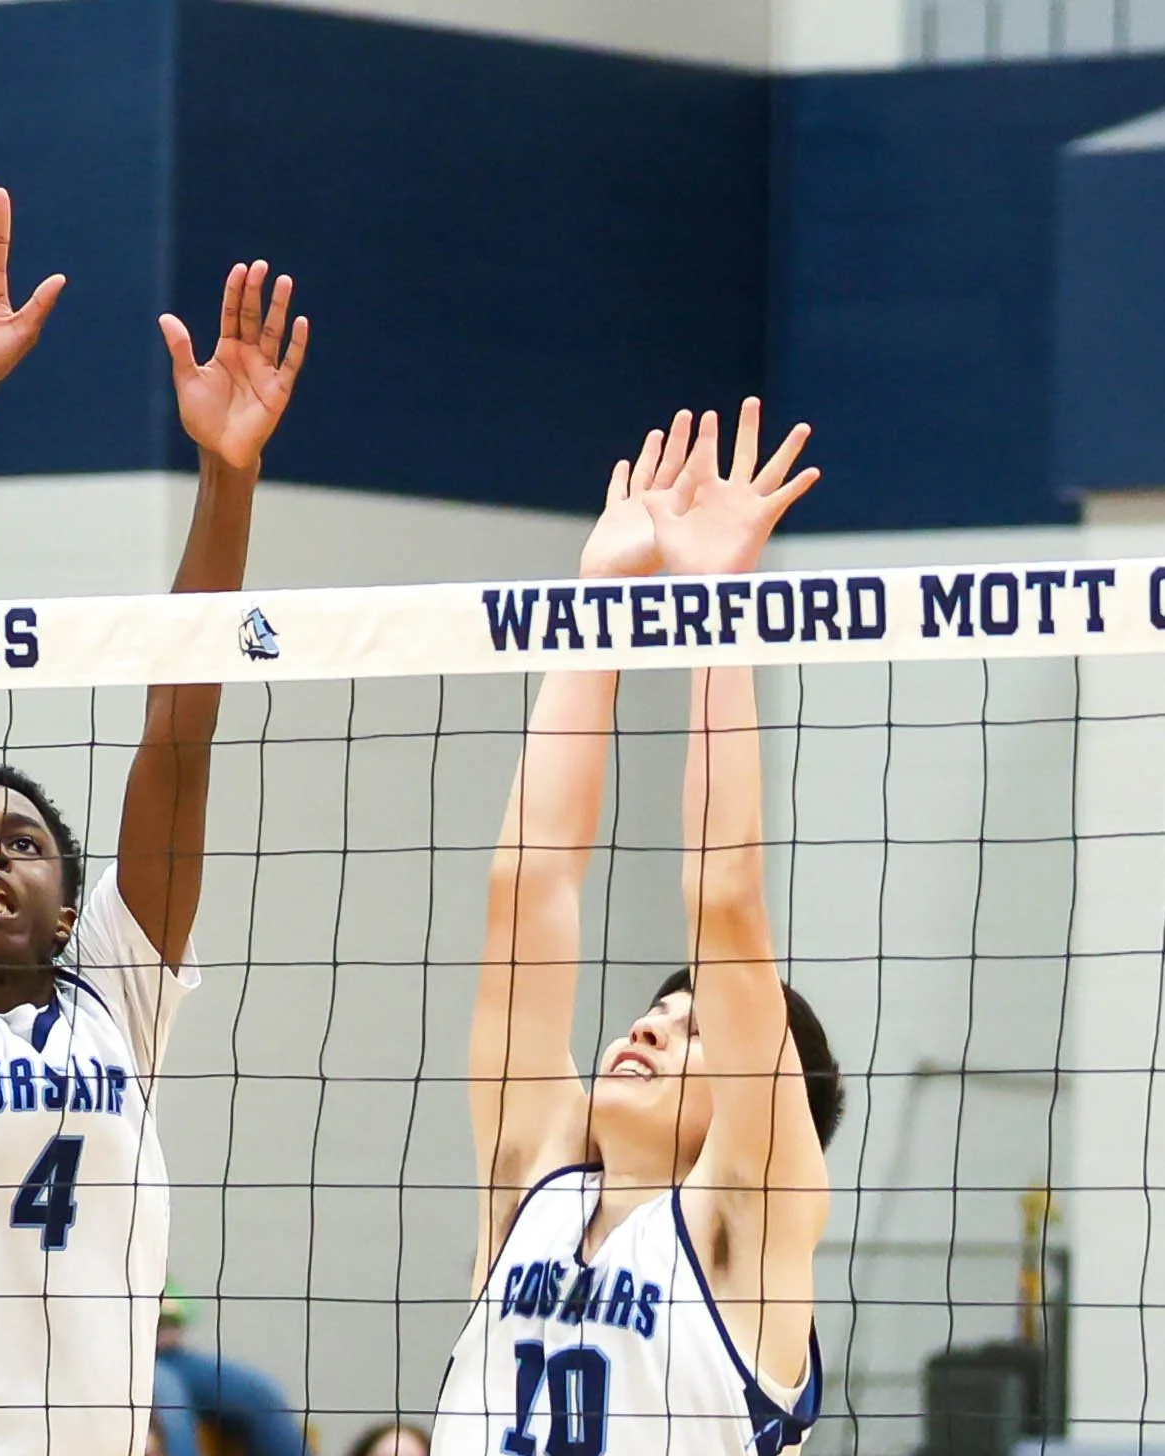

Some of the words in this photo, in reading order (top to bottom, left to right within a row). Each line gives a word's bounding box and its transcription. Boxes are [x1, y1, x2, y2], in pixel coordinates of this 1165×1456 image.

[482, 576, 887, 651] WATERFORD
[920, 568, 1116, 638] MOTT
[9, 1135, 86, 1252] 4
